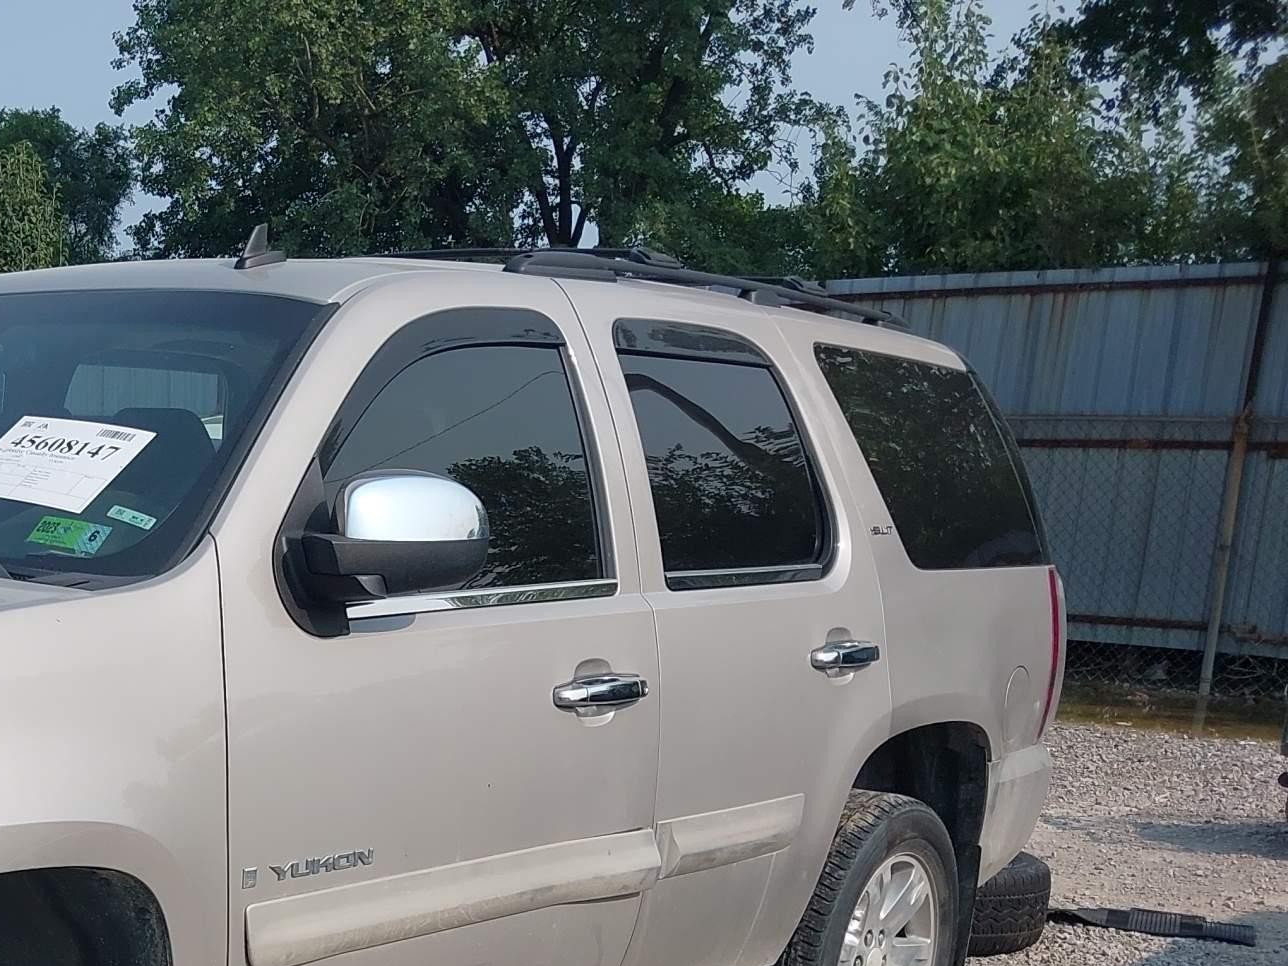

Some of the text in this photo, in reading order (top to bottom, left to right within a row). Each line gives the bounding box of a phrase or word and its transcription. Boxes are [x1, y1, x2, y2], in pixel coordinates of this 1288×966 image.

[11, 434, 121, 462] 45608147
[88, 530, 100, 542] 6
[269, 848, 373, 881] YUKON
